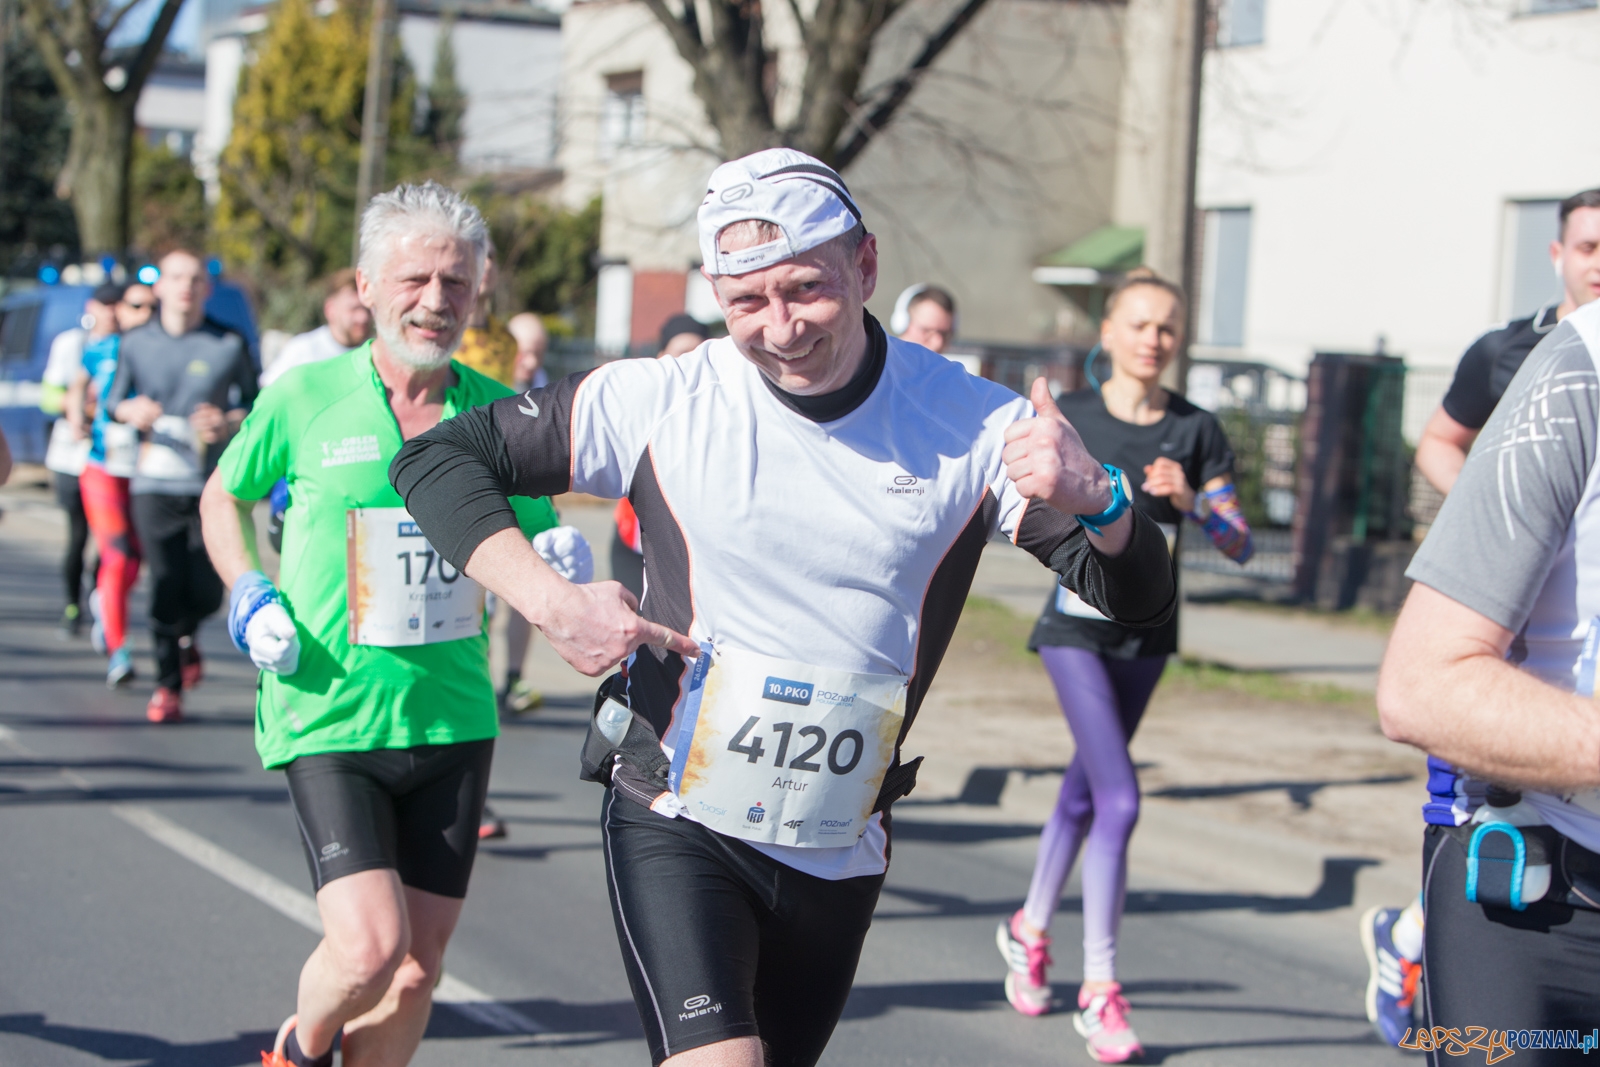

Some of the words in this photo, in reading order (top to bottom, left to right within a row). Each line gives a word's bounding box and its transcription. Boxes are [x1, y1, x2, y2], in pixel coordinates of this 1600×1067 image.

[737, 254, 766, 265] Kalenji
[341, 434, 378, 446] ORLEN
[332, 444, 379, 457] WARSAW
[321, 452, 381, 468] MARATHON
[886, 486, 925, 496] Kalenji
[408, 589, 453, 601] Krzysztof
[768, 683, 783, 696] 10.
[784, 685, 809, 699] PKO
[726, 715, 864, 776] 4120
[771, 777, 809, 793] Artur
[783, 819, 805, 830] 4F
[678, 1002, 723, 1022] Kalenji
